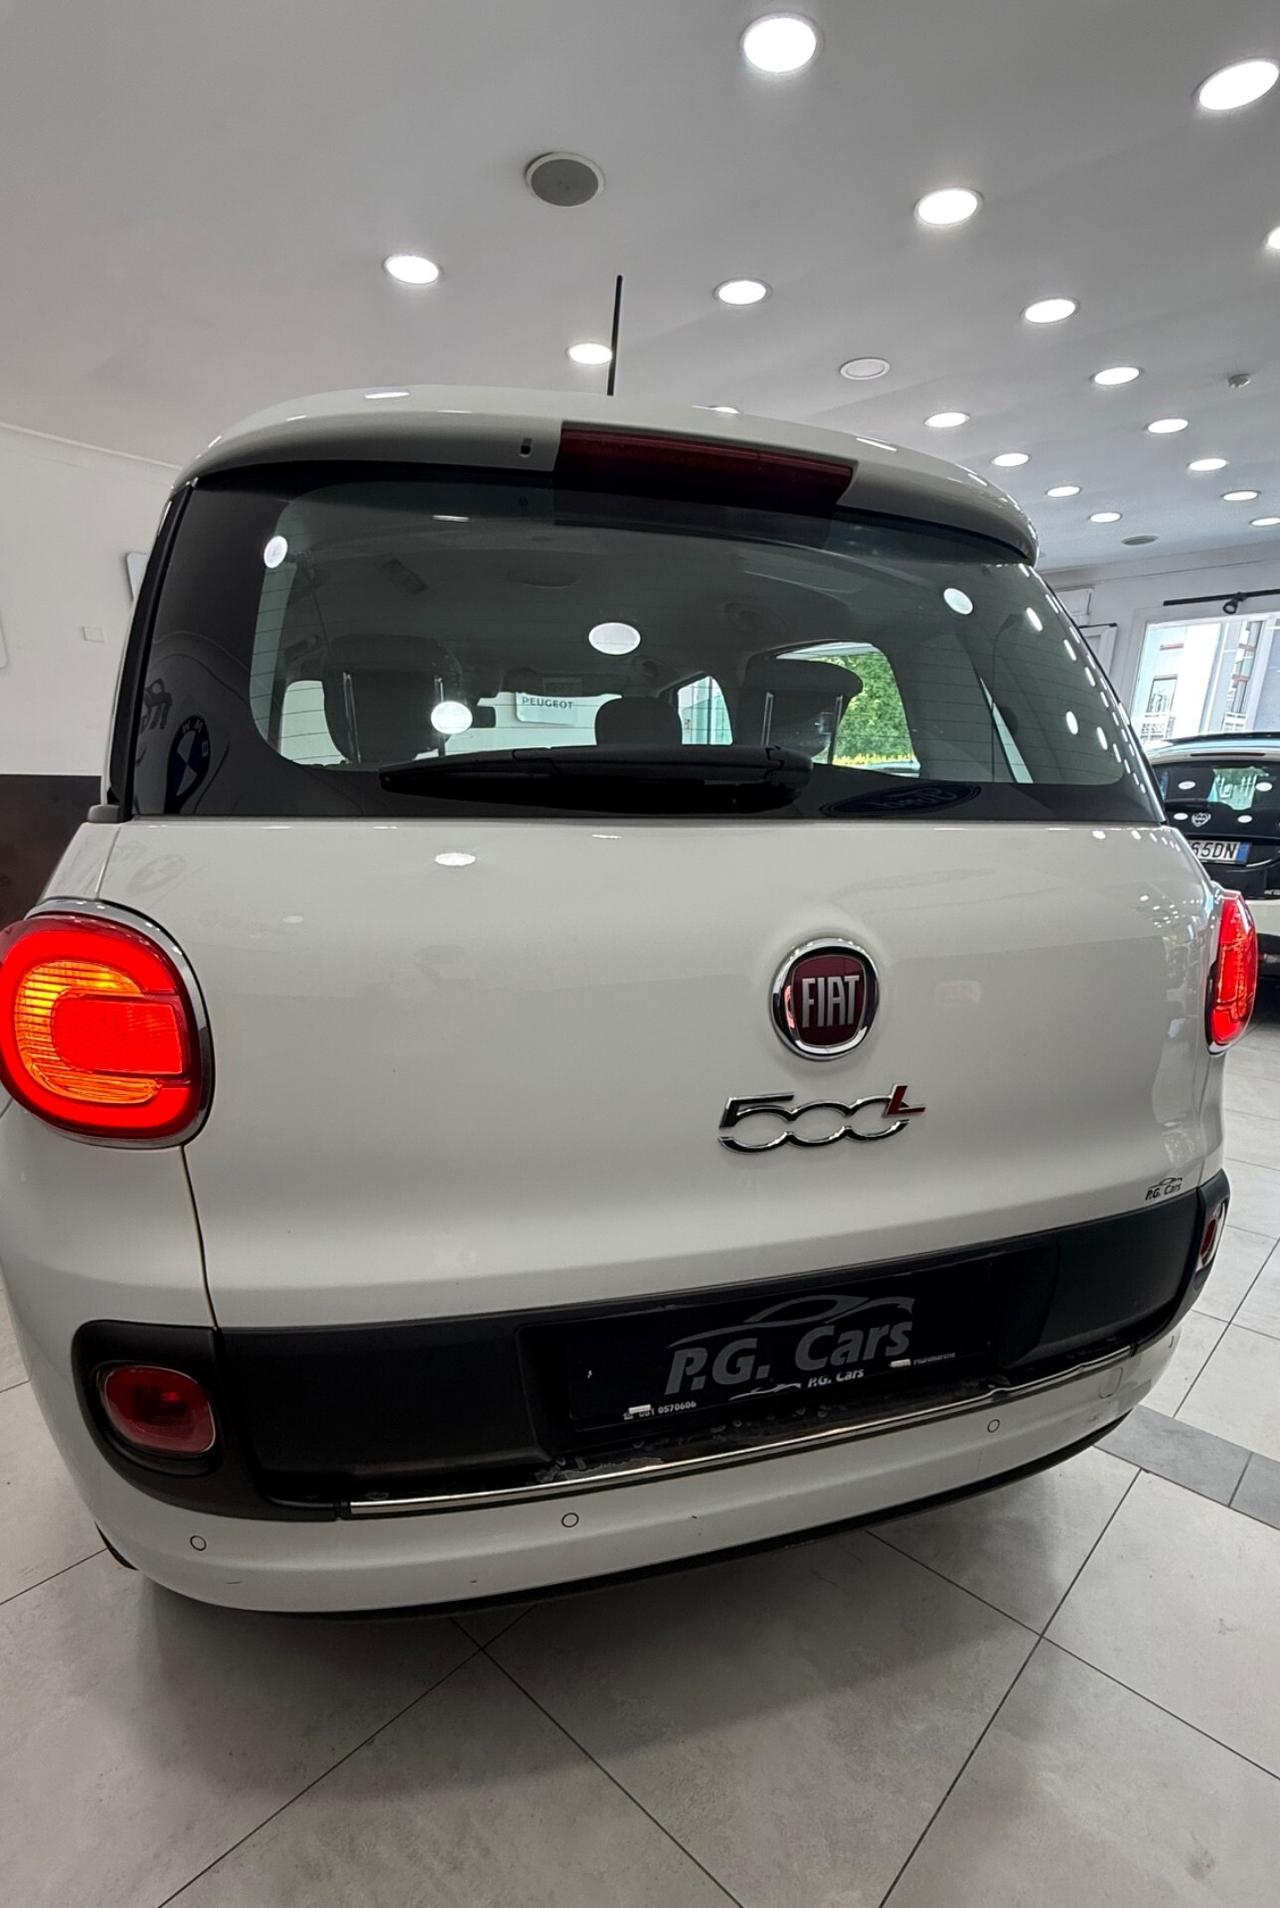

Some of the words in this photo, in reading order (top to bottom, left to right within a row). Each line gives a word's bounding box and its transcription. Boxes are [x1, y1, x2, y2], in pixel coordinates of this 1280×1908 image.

[522, 696, 574, 709] PEUGEOT
[802, 975, 860, 1028] FIAT
[664, 1337, 769, 1395] P.G.
[795, 1320, 913, 1371] Cars
